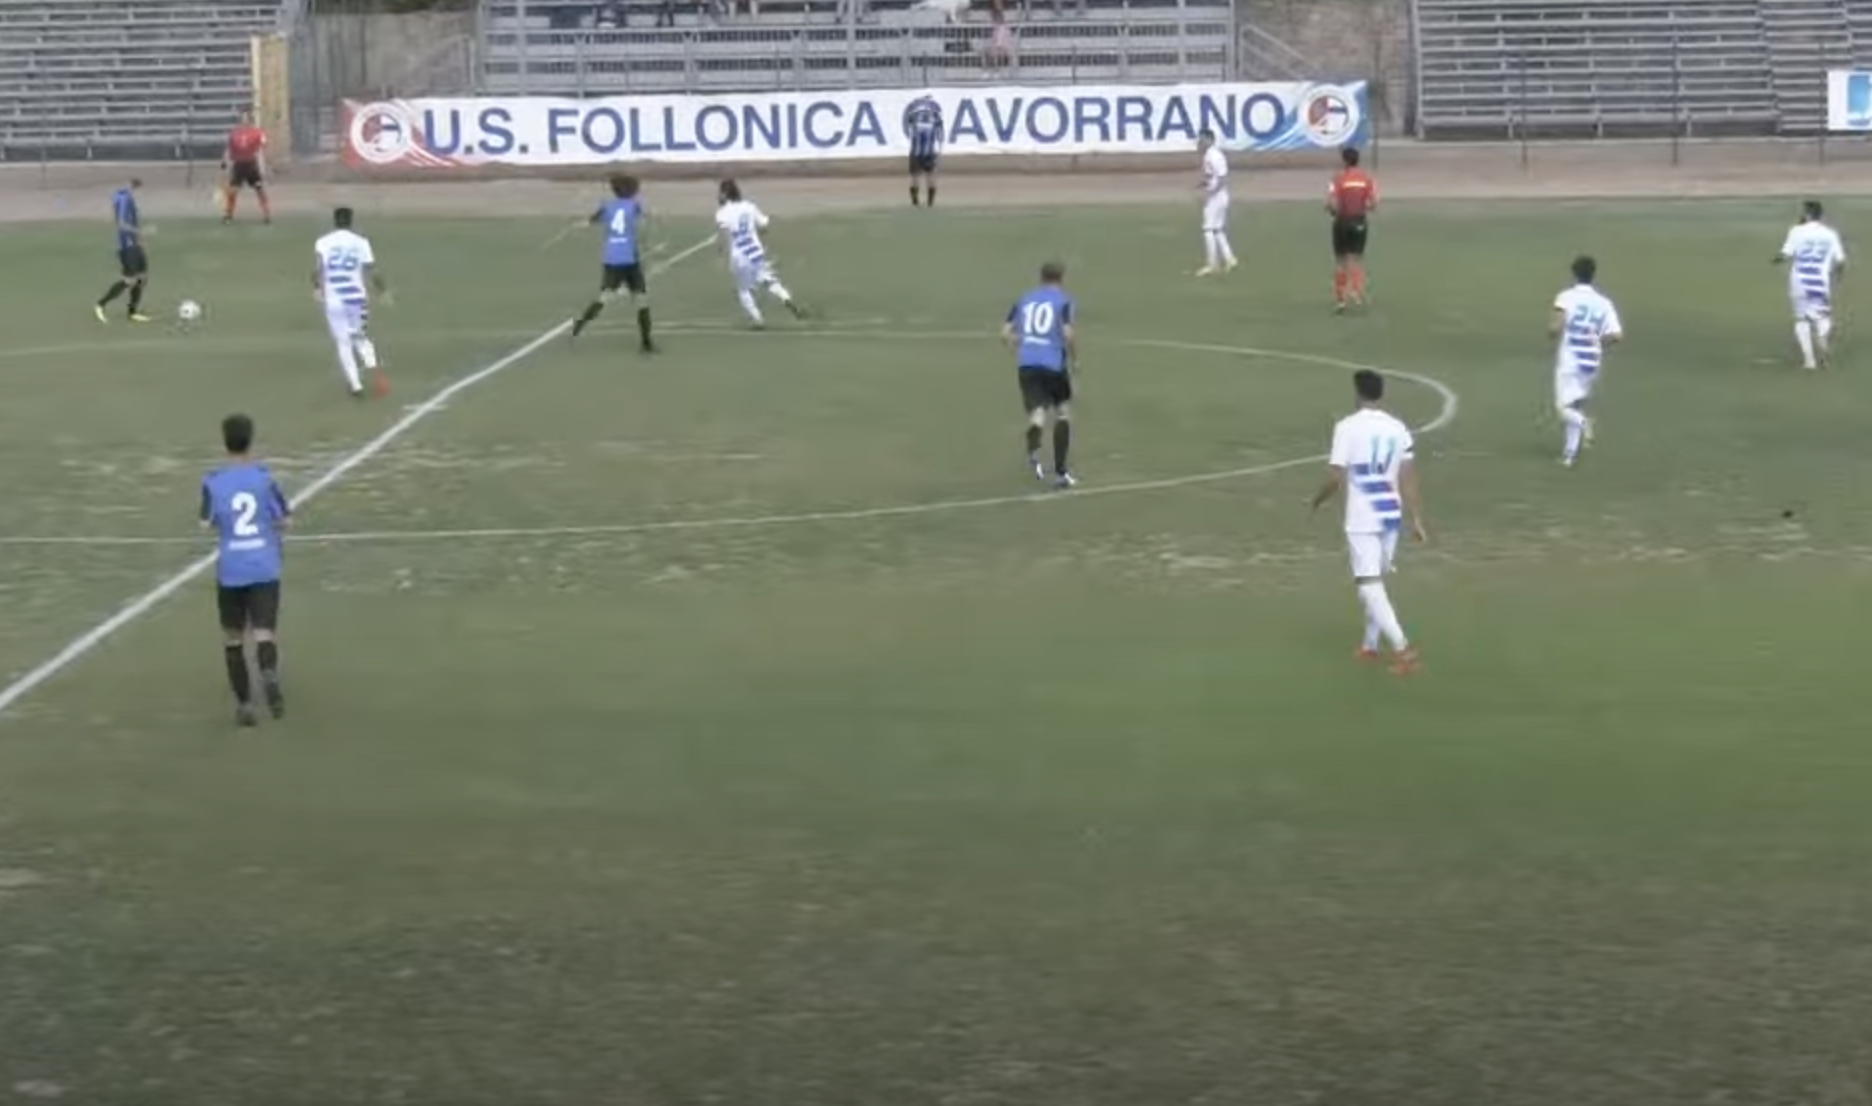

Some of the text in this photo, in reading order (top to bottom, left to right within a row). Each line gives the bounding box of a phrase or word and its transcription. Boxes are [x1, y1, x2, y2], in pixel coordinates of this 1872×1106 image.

[424, 108, 529, 154] U.S.
[547, 102, 887, 153] FOLLONICA
[610, 208, 626, 235] 4
[1023, 301, 1054, 336] 10
[231, 491, 260, 536] 2
